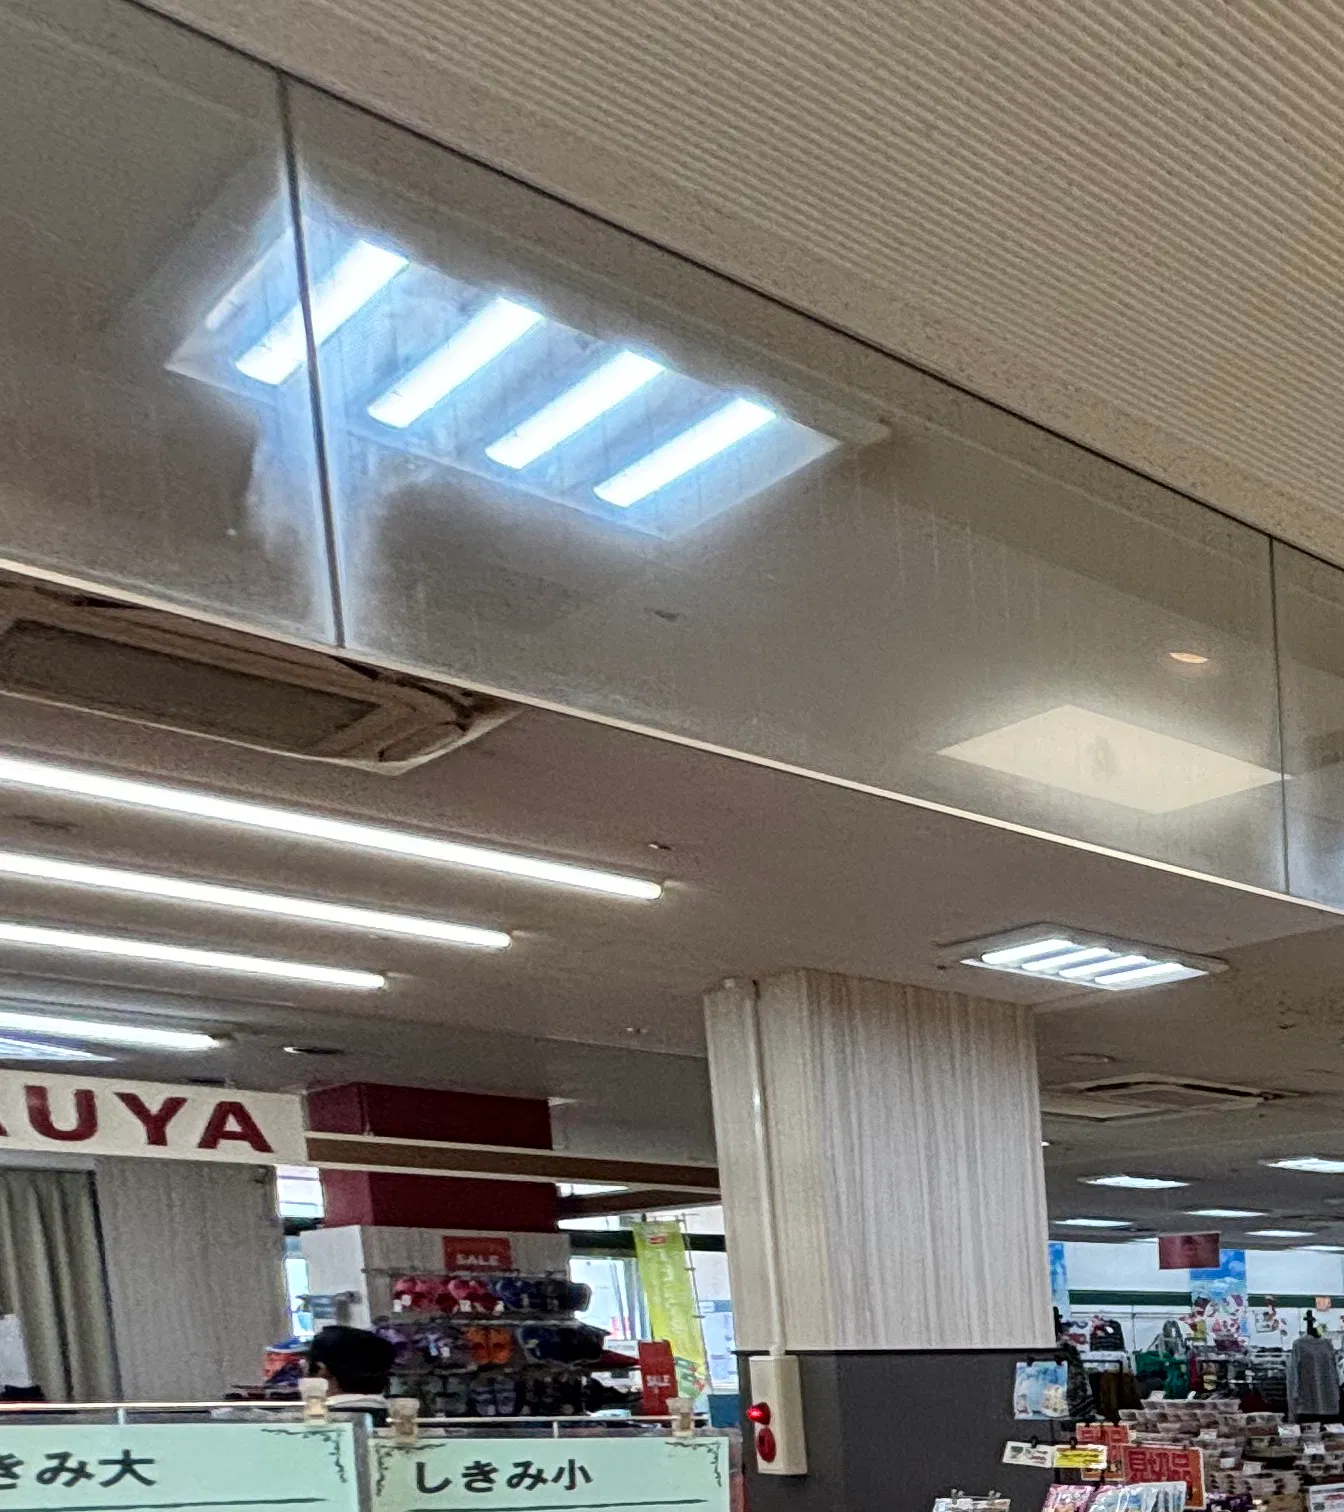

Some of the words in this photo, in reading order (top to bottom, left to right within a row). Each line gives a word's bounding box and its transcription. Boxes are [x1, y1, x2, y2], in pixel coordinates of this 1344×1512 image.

[0, 1084, 275, 1153] UYA
[455, 1253, 499, 1267] SALE
[414, 1458, 594, 1494] しきみ小
